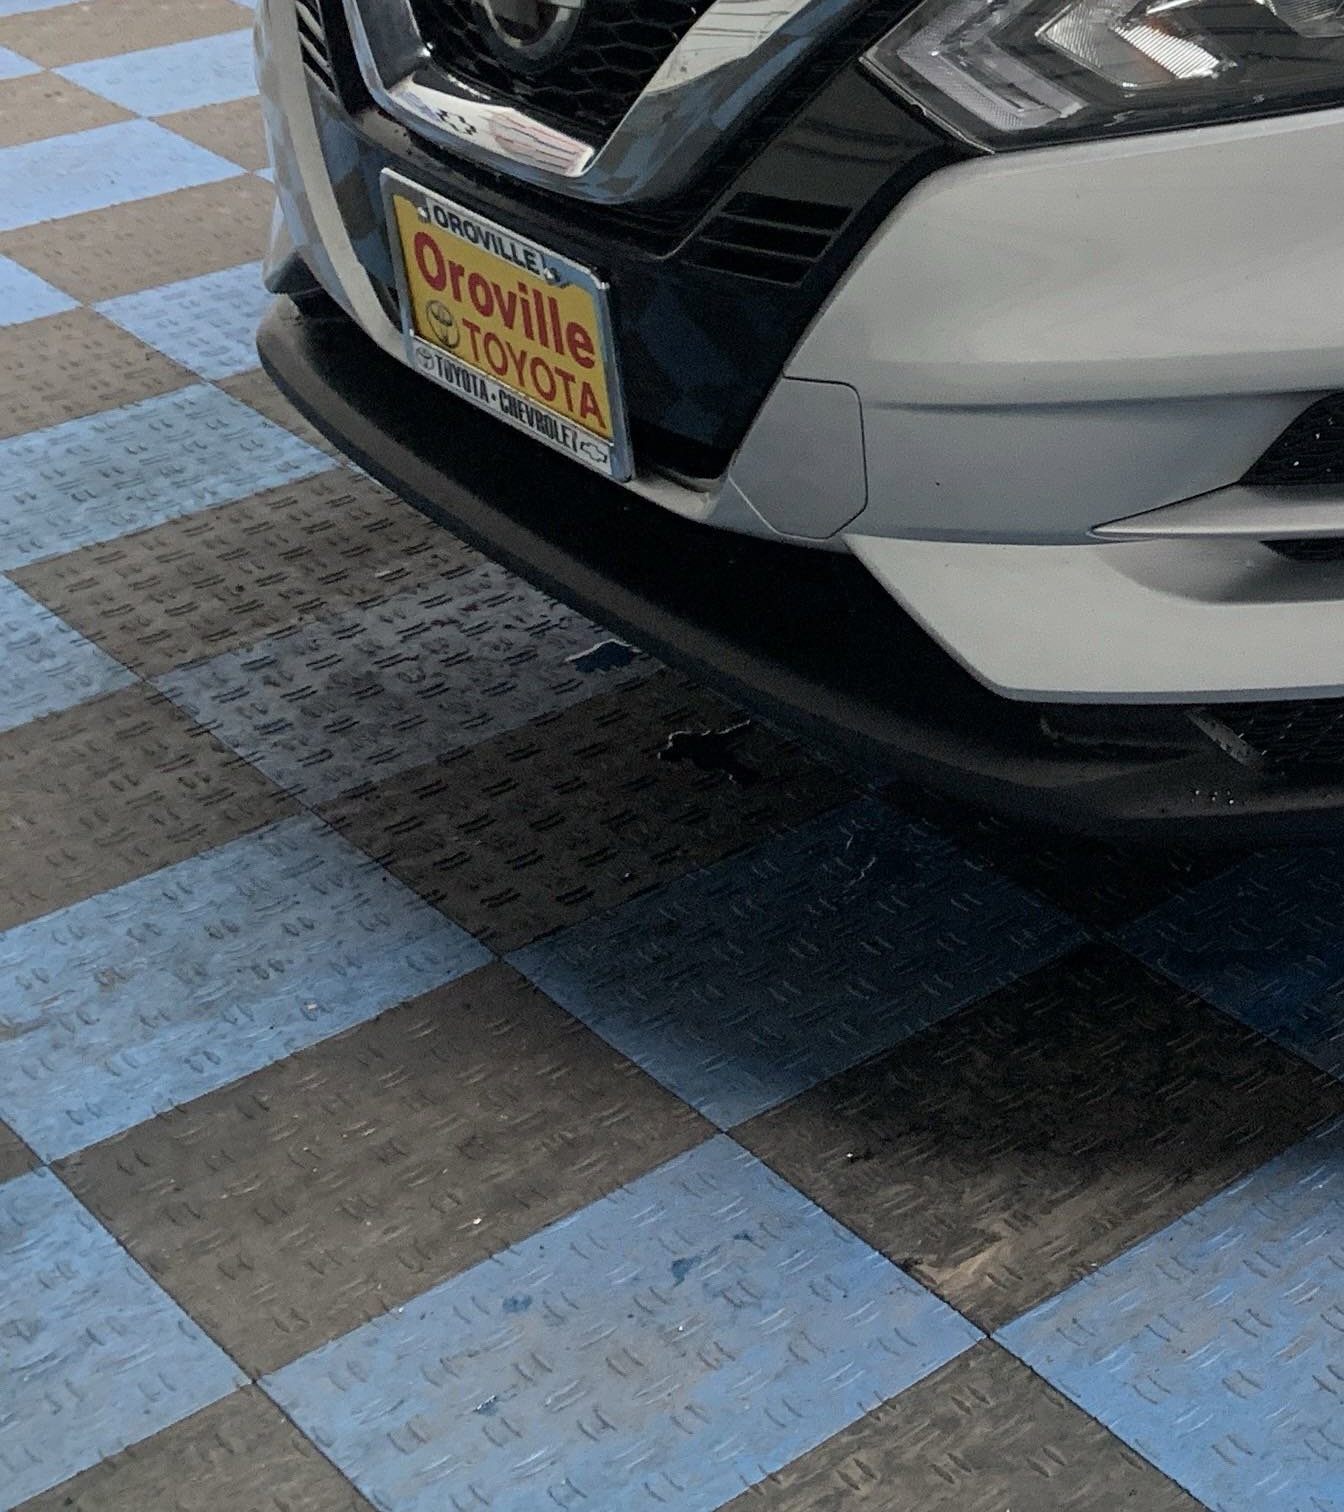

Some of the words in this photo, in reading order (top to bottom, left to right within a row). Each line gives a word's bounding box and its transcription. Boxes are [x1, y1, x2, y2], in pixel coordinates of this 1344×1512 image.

[433, 204, 541, 276] OROVILLE
[413, 231, 596, 369] Oroville
[434, 354, 490, 404] TOYOTA
[499, 391, 580, 453] CHEVROLET
[461, 317, 608, 430] TOYOTA
